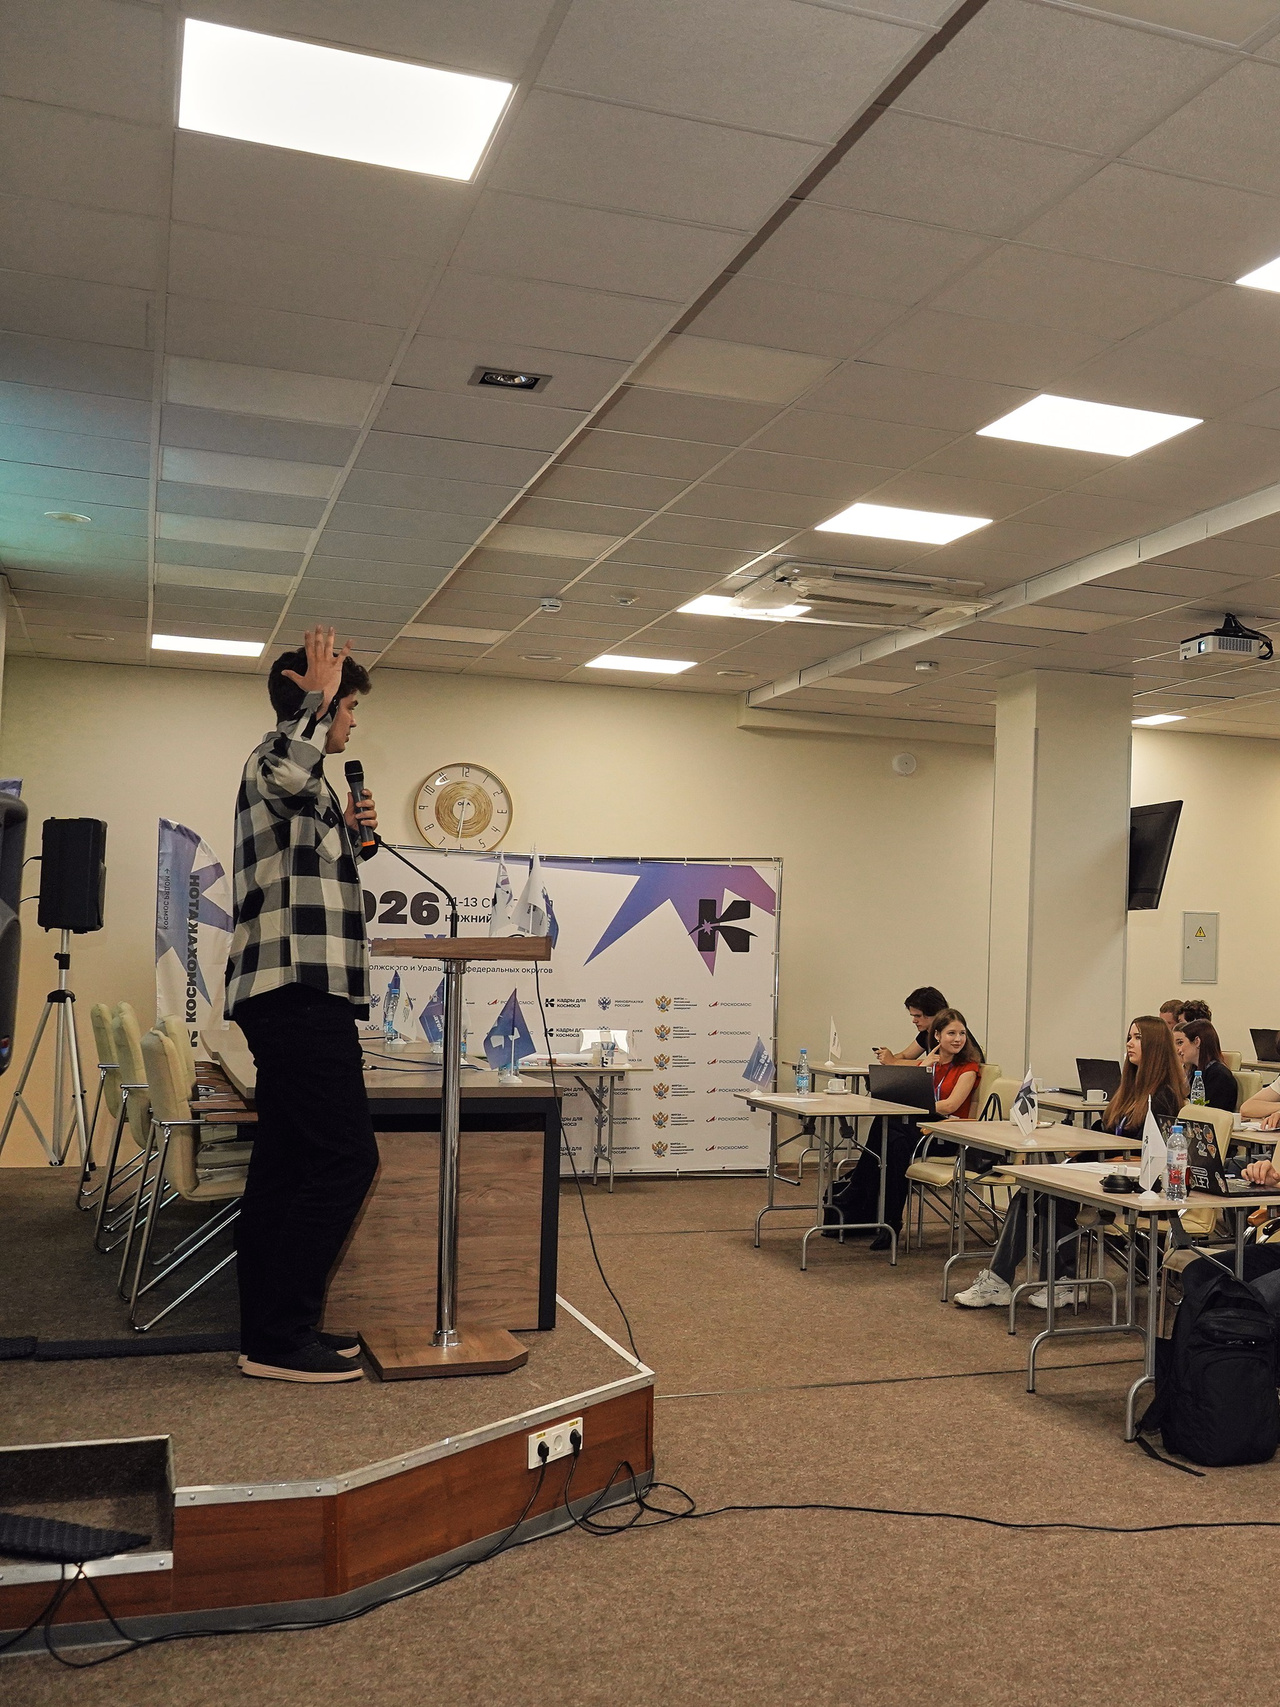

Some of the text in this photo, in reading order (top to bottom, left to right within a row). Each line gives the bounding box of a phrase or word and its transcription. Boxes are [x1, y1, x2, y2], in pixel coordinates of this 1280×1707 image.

[462, 767, 470, 777] 12
[423, 785, 435, 796] 10
[424, 823, 434, 831] 8
[478, 839, 486, 848] 5
